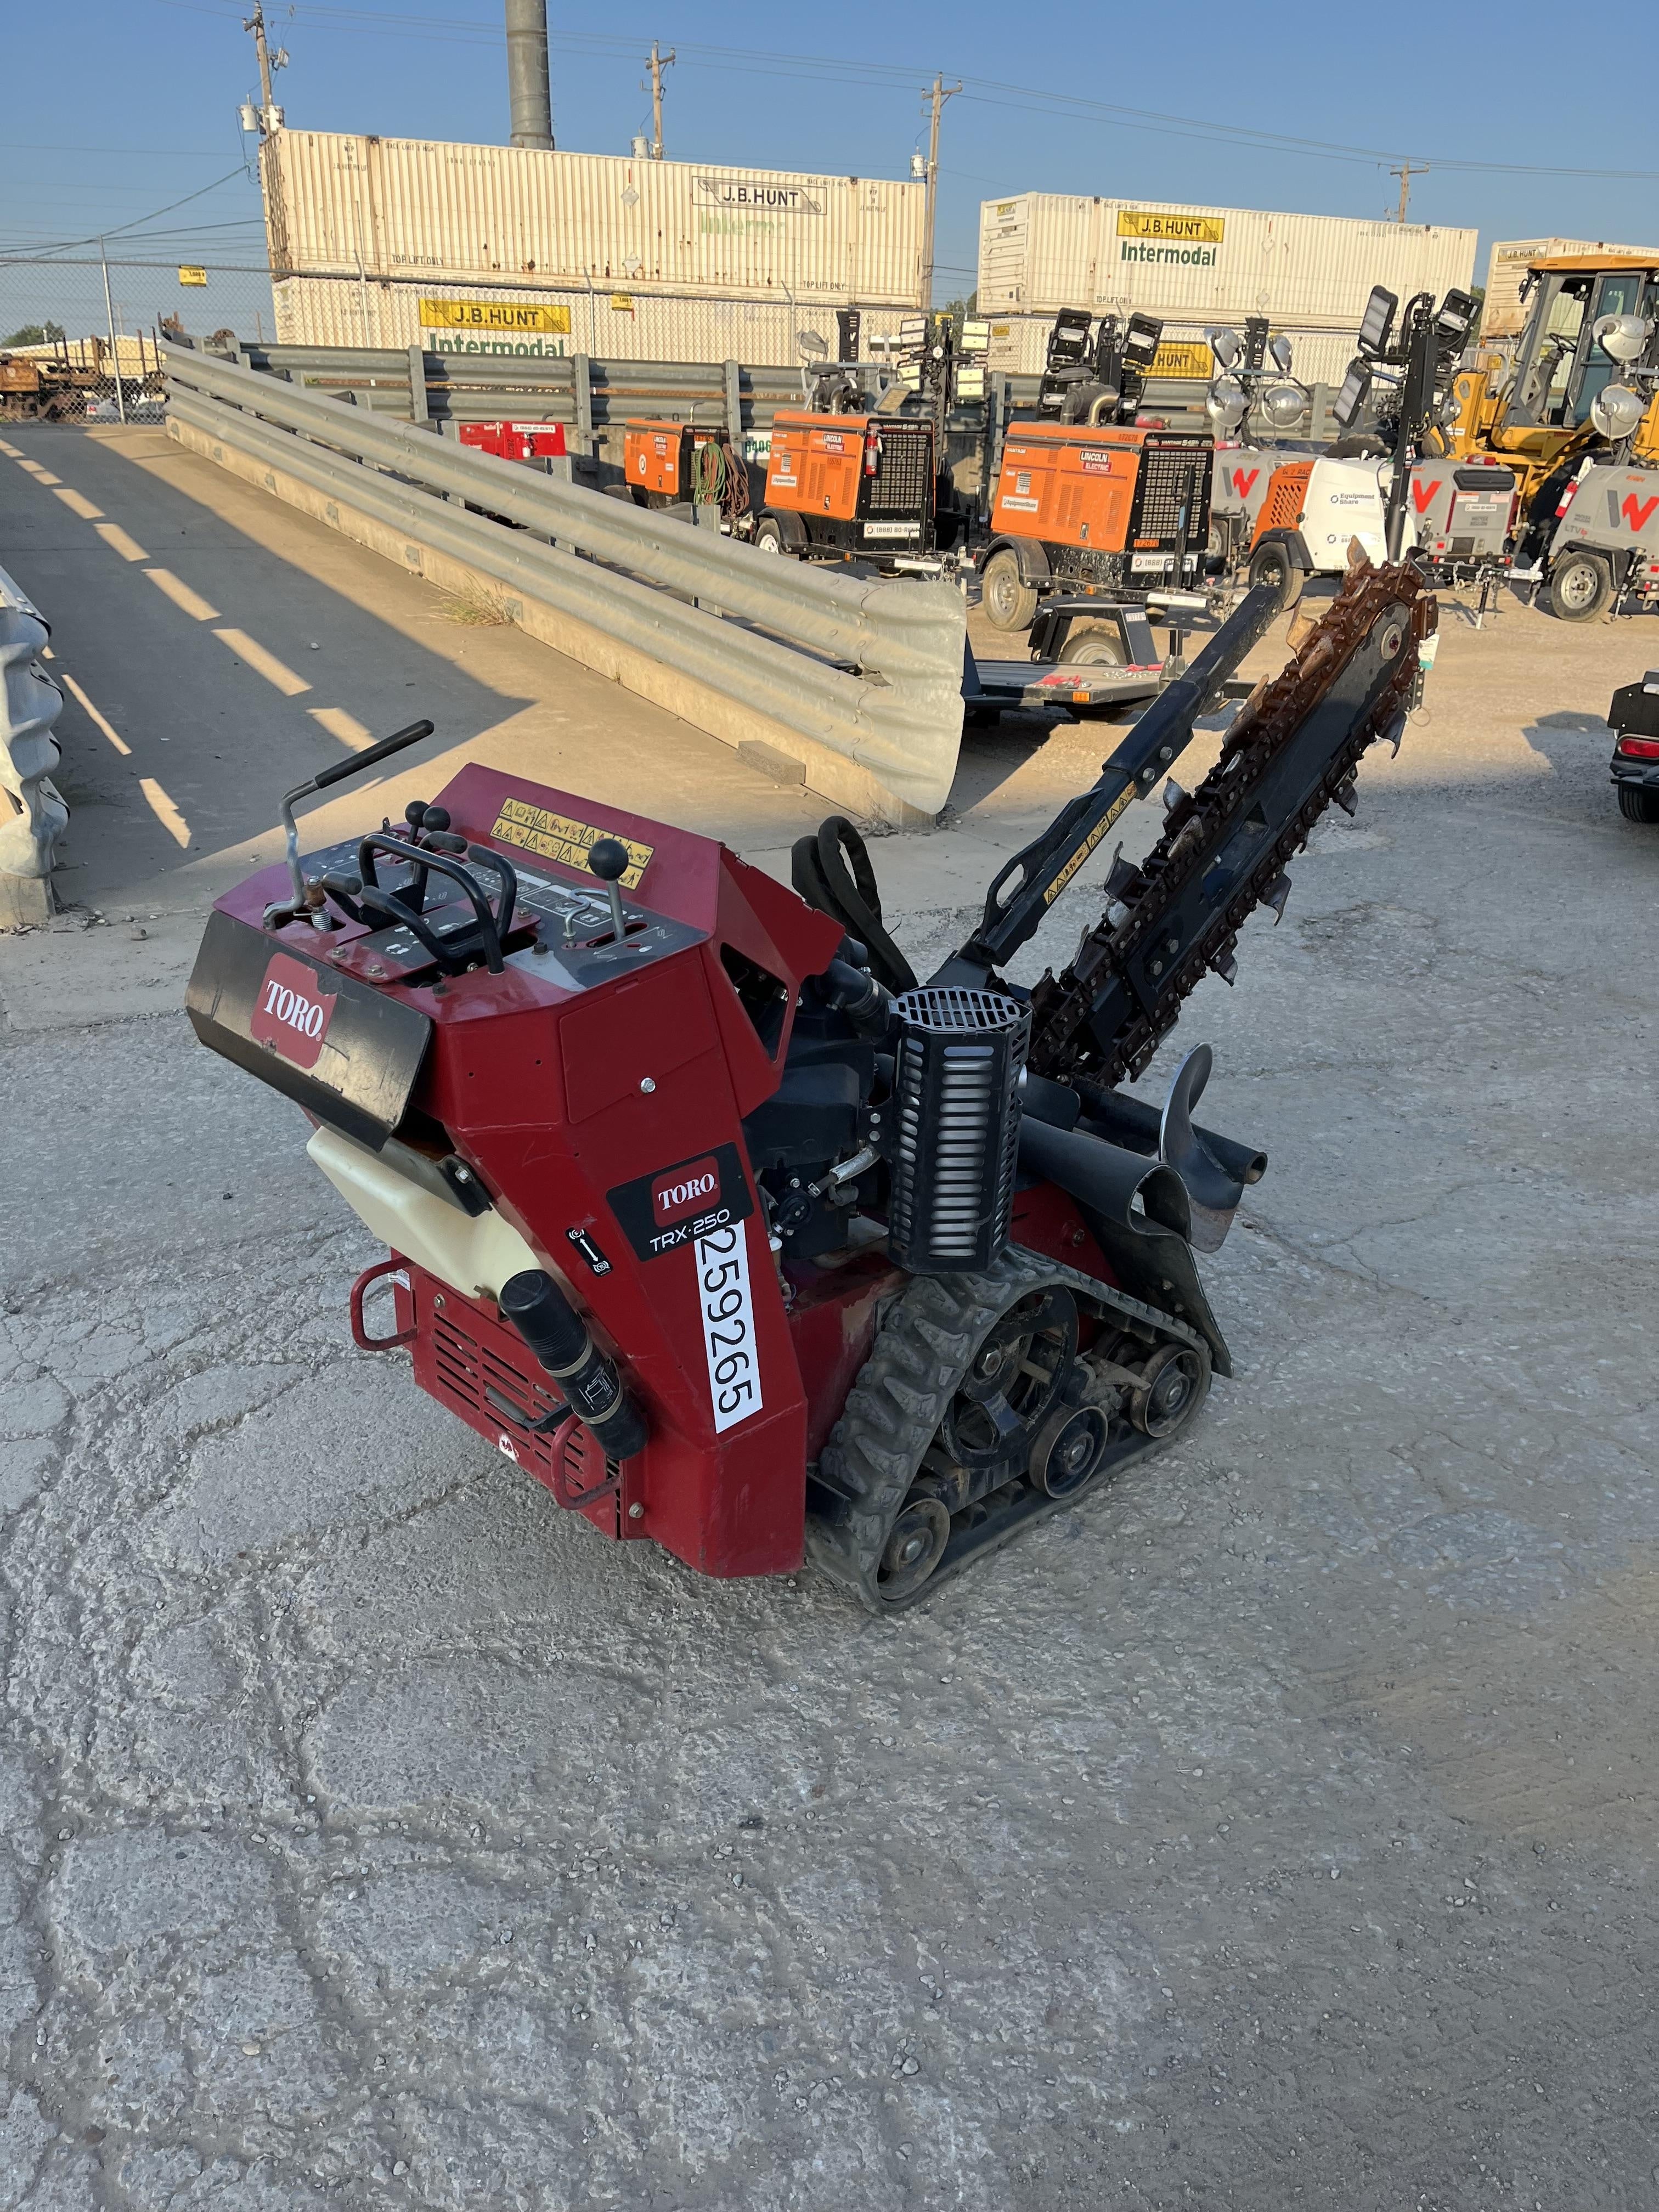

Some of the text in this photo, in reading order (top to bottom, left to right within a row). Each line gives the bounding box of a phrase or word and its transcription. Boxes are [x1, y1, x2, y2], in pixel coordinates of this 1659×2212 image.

[392, 255, 444, 266] TOP LIFT ONLY
[1121, 241, 1217, 267] Intermodal
[803, 280, 845, 291] TOP LIFT ONLY
[430, 333, 564, 357] Intermodal
[824, 434, 842, 443] LINCOLN
[1081, 451, 1108, 462] LINCOLN
[1085, 463, 1109, 471] ELECTRIC
[263, 980, 324, 1038] TORO
[658, 1173, 715, 1210] TORO
[699, 1227, 753, 1414] 259265
